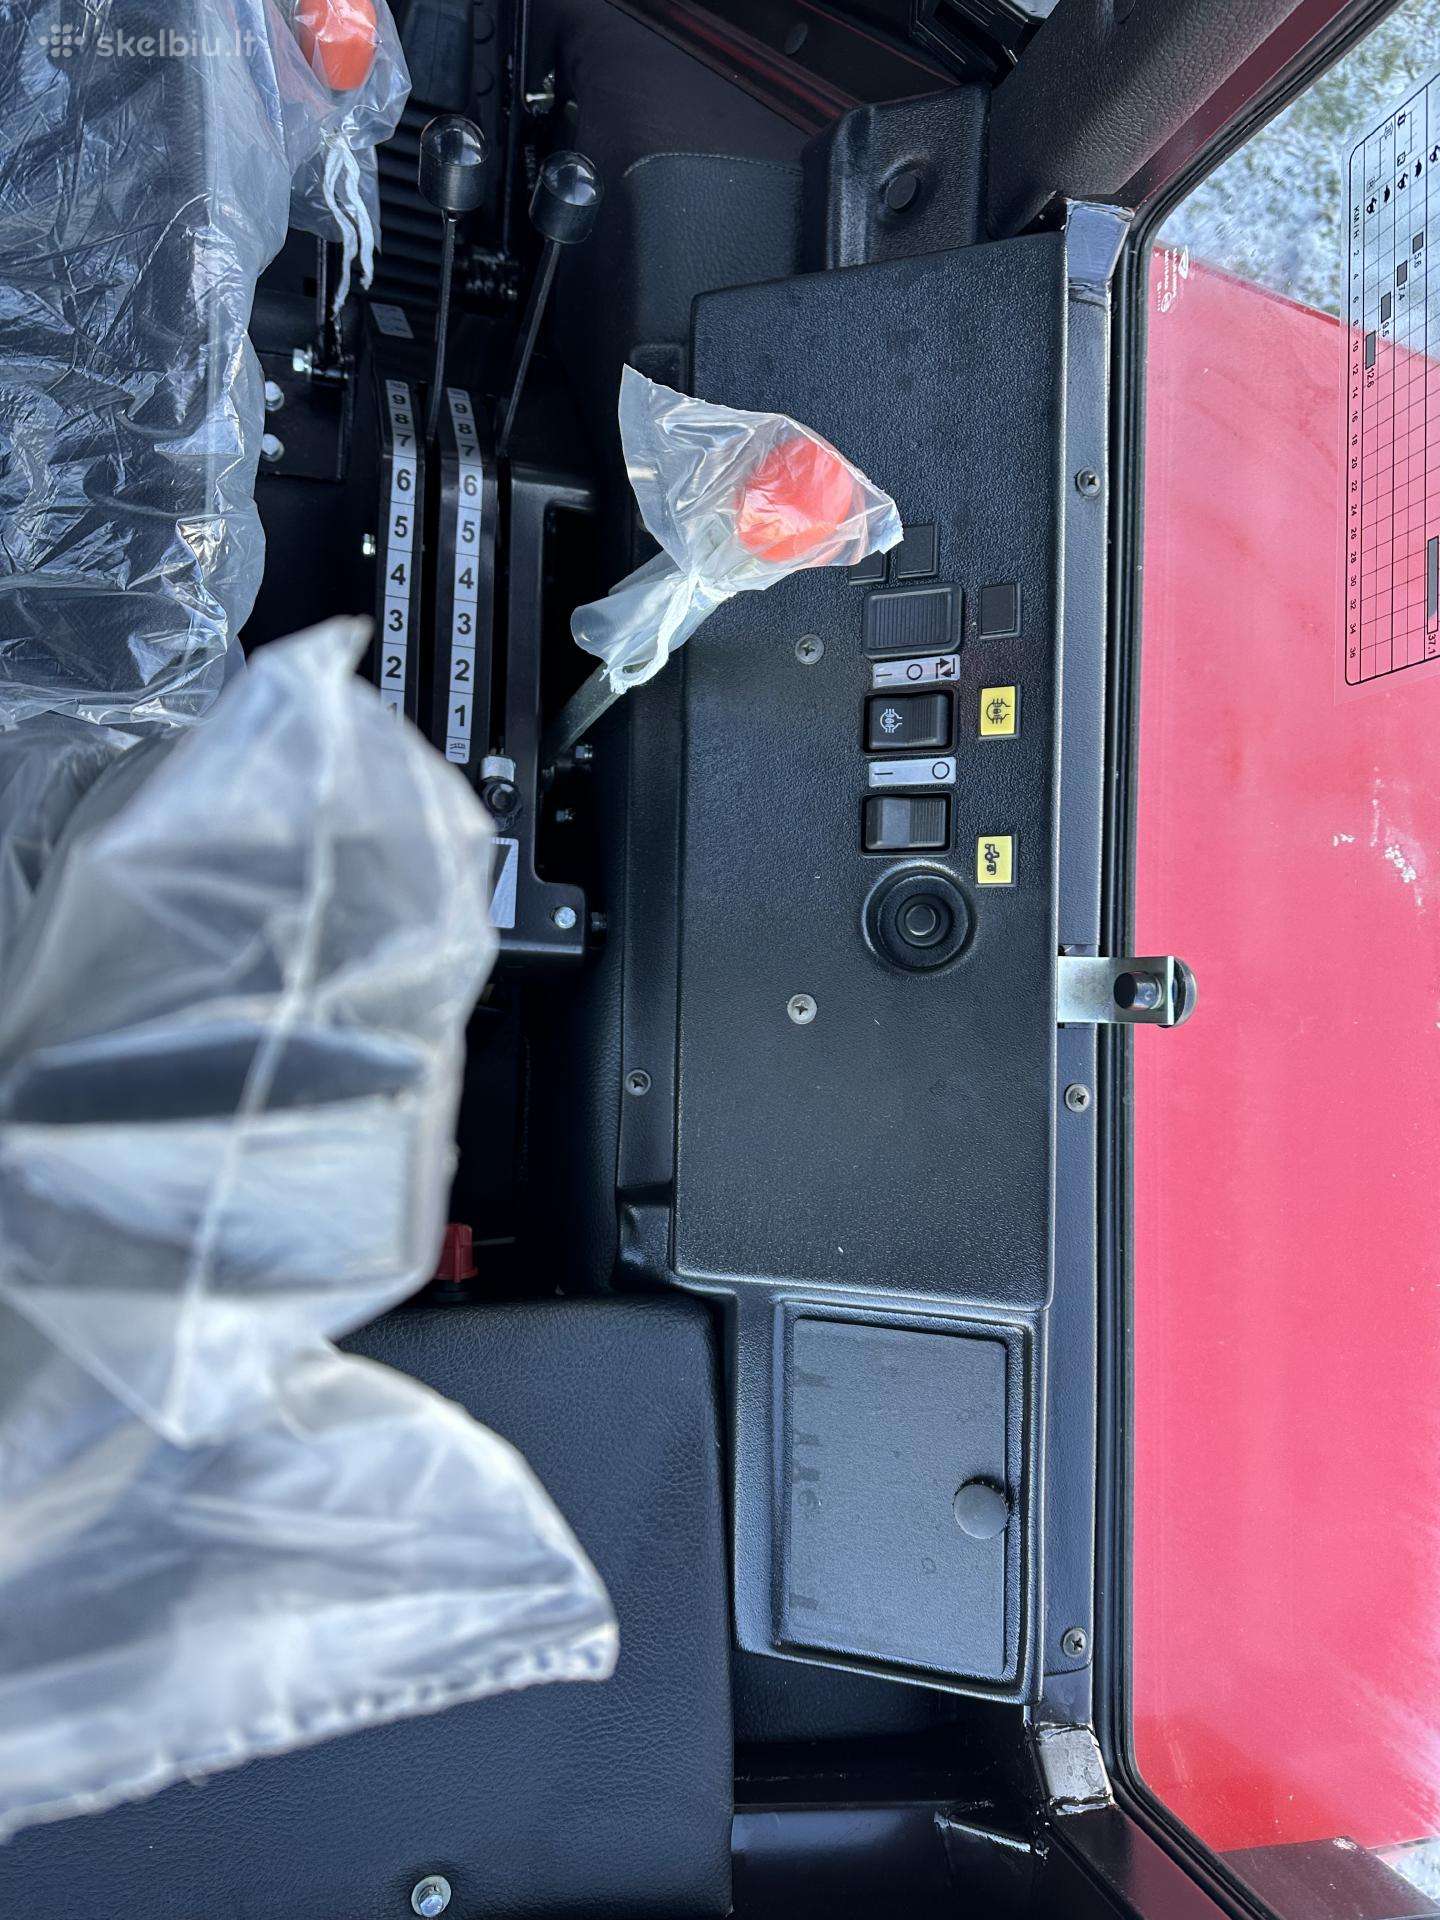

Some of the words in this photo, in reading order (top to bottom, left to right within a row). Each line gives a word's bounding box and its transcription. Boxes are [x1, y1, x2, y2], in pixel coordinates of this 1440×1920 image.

[1352, 340, 1359, 352] 10
[1352, 363, 1358, 375] 12
[1366, 367, 1375, 388] 12.6
[392, 394, 406, 405] 9
[1352, 387, 1358, 399] 14
[454, 403, 468, 414] 9
[395, 413, 410, 425] 8
[1352, 411, 1358, 423] 16
[458, 424, 473, 435] 8
[396, 434, 411, 447] 7
[1351, 434, 1358, 446] 18
[461, 444, 475, 457] 7
[1351, 457, 1358, 469] 20
[396, 469, 411, 491] 6
[464, 475, 478, 496] 6
[1351, 480, 1358, 492] 22
[1350, 504, 1357, 516] 24
[394, 515, 408, 538] 5
[461, 520, 475, 543] 5
[1350, 528, 1357, 540] 26
[1350, 551, 1357, 564] 28
[390, 563, 406, 586] 4
[458, 567, 474, 589] 4
[1350, 575, 1357, 587] 30
[1350, 599, 1356, 610] 32
[388, 609, 404, 632] 3
[457, 613, 472, 635] 3
[1349, 622, 1356, 635] 34
[1428, 634, 1437, 655] 37.1
[1349, 646, 1356, 659] 36
[385, 656, 402, 679] 2
[454, 659, 470, 682] 2
[454, 704, 467, 727] 1
